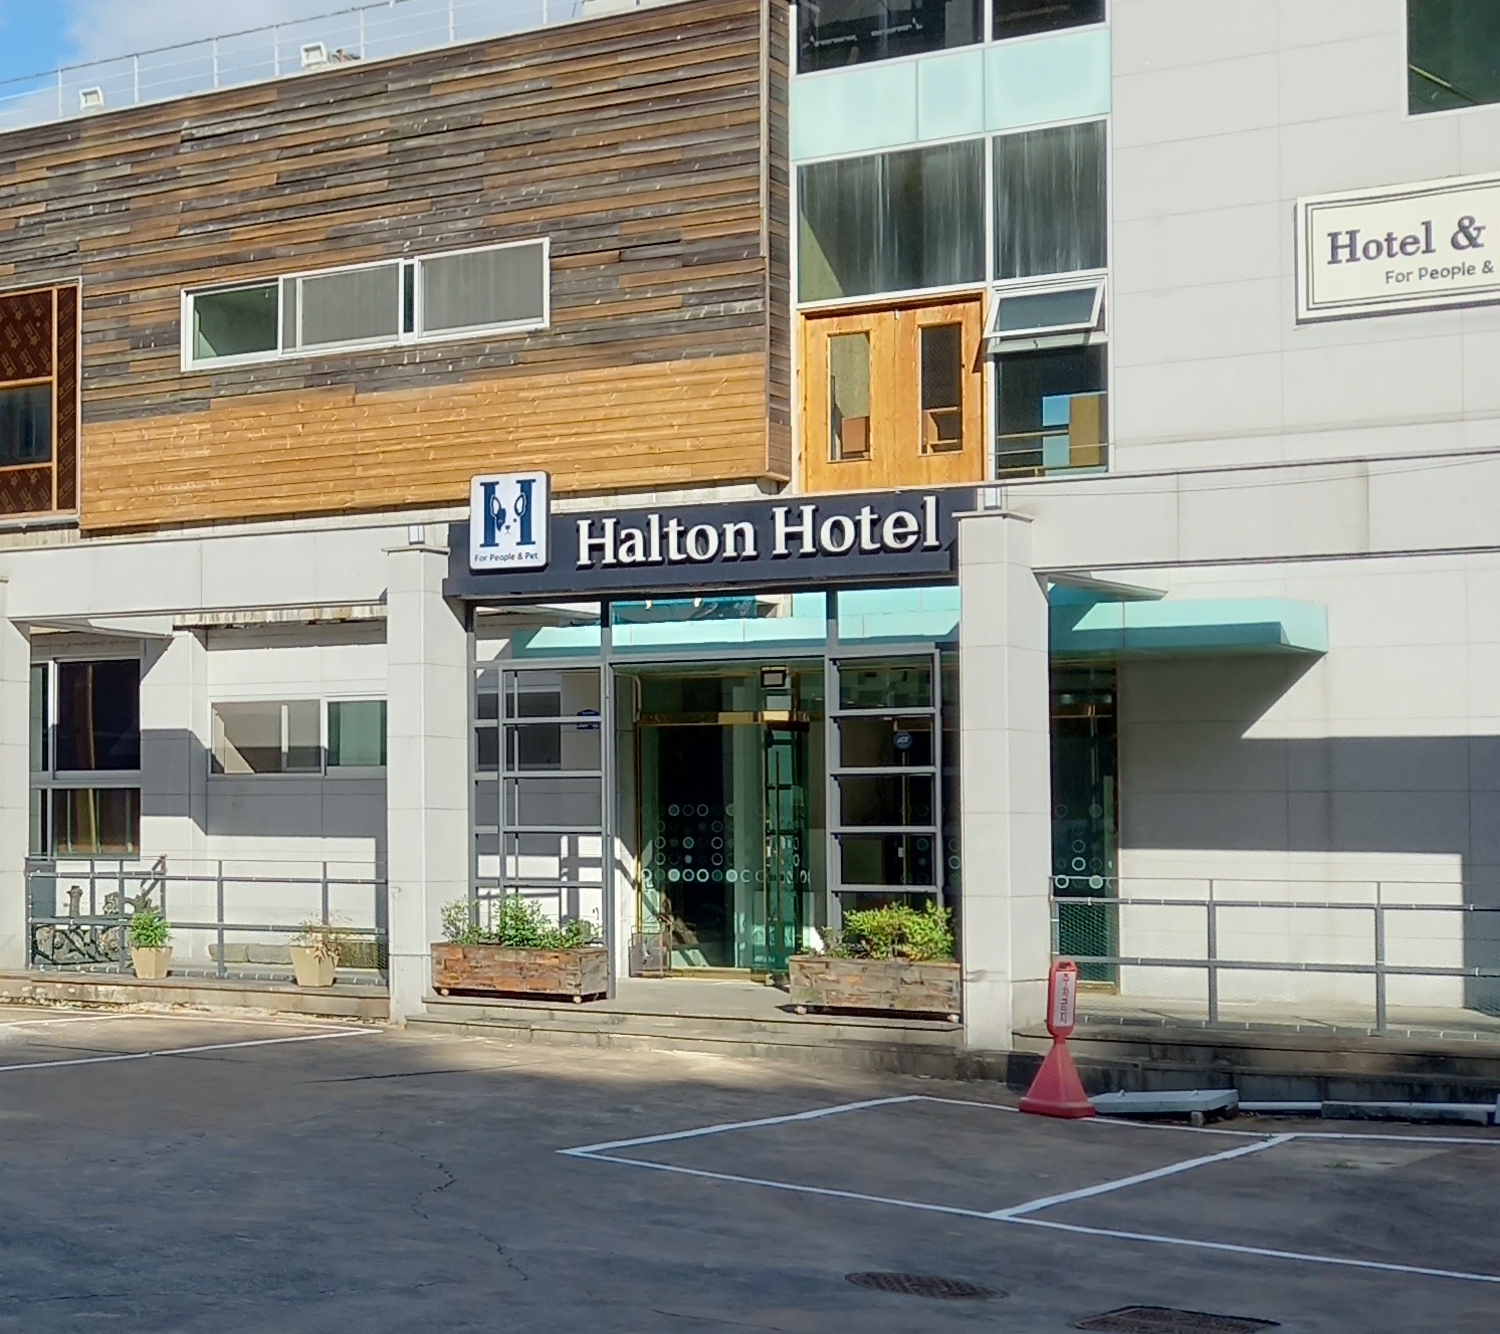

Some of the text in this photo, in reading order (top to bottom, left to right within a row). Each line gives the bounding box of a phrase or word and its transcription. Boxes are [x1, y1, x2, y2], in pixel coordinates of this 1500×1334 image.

[1327, 215, 1486, 265] Hotel &
[1385, 260, 1494, 284] For People &
[576, 495, 940, 565] Halton Hotel
[474, 554, 488, 562] For
[489, 552, 515, 562] People
[525, 551, 538, 560] Pet
